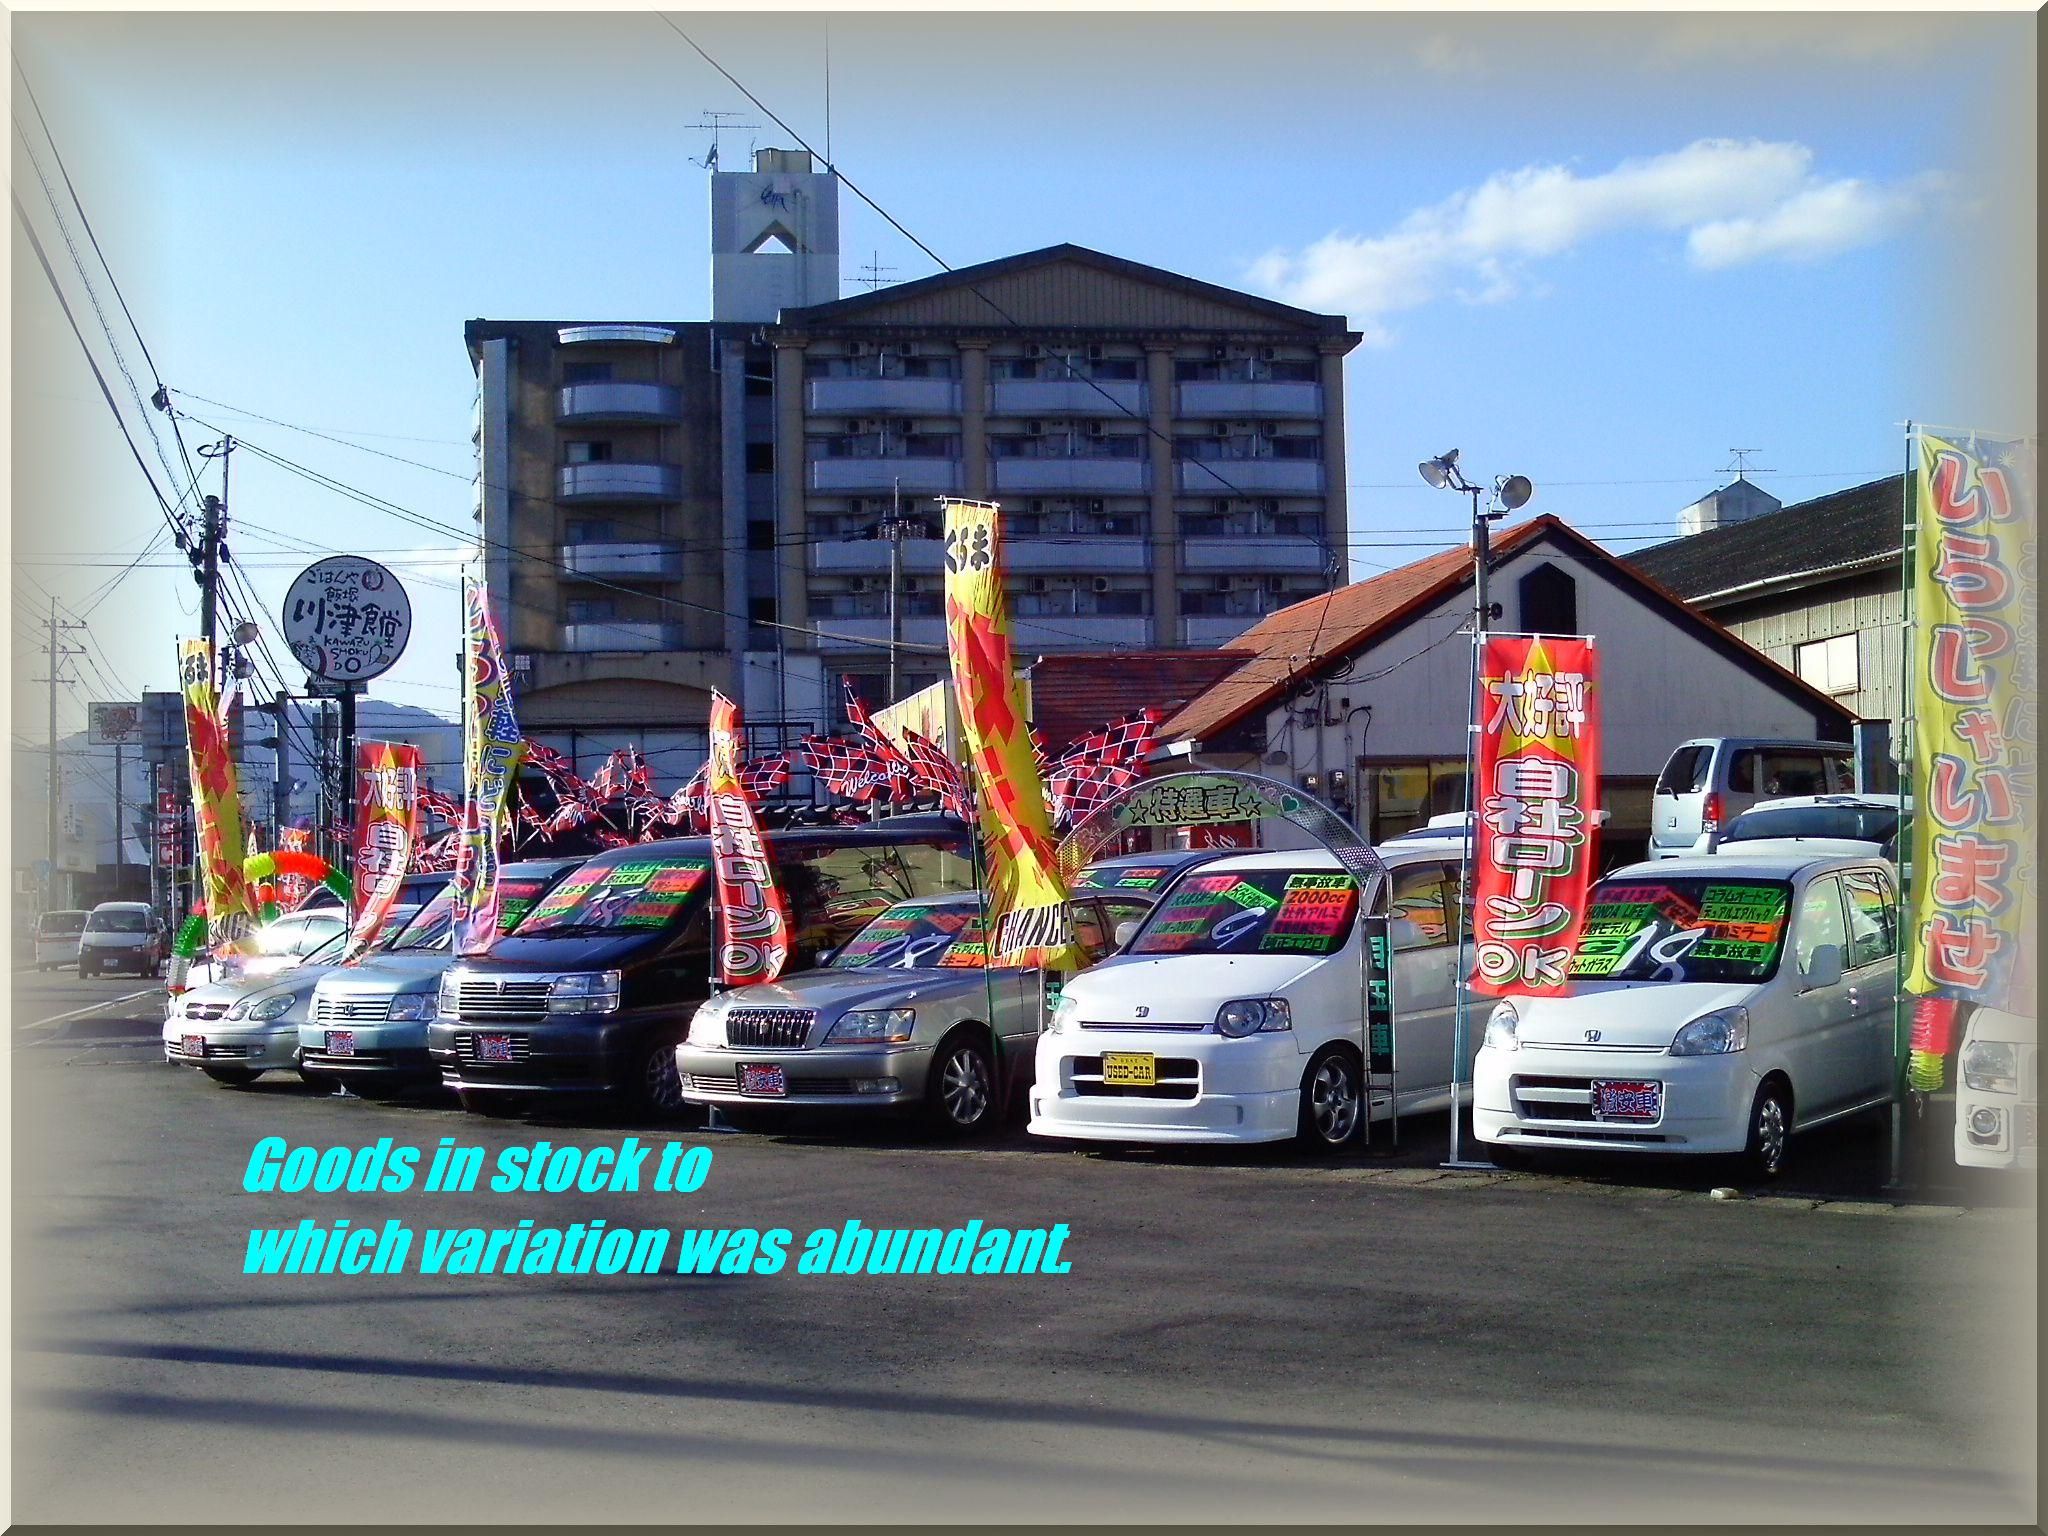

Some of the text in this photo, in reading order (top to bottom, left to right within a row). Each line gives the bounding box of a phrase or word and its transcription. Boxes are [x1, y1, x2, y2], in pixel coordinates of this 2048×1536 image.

[307, 569, 359, 585] ごはんや
[293, 598, 403, 649] 川津食堂
[1487, 669, 1585, 740] 大好評
[364, 764, 417, 812] 大好評
[1286, 891, 1347, 904] 2000cc
[1106, 1065, 1152, 1080] USED-CAR
